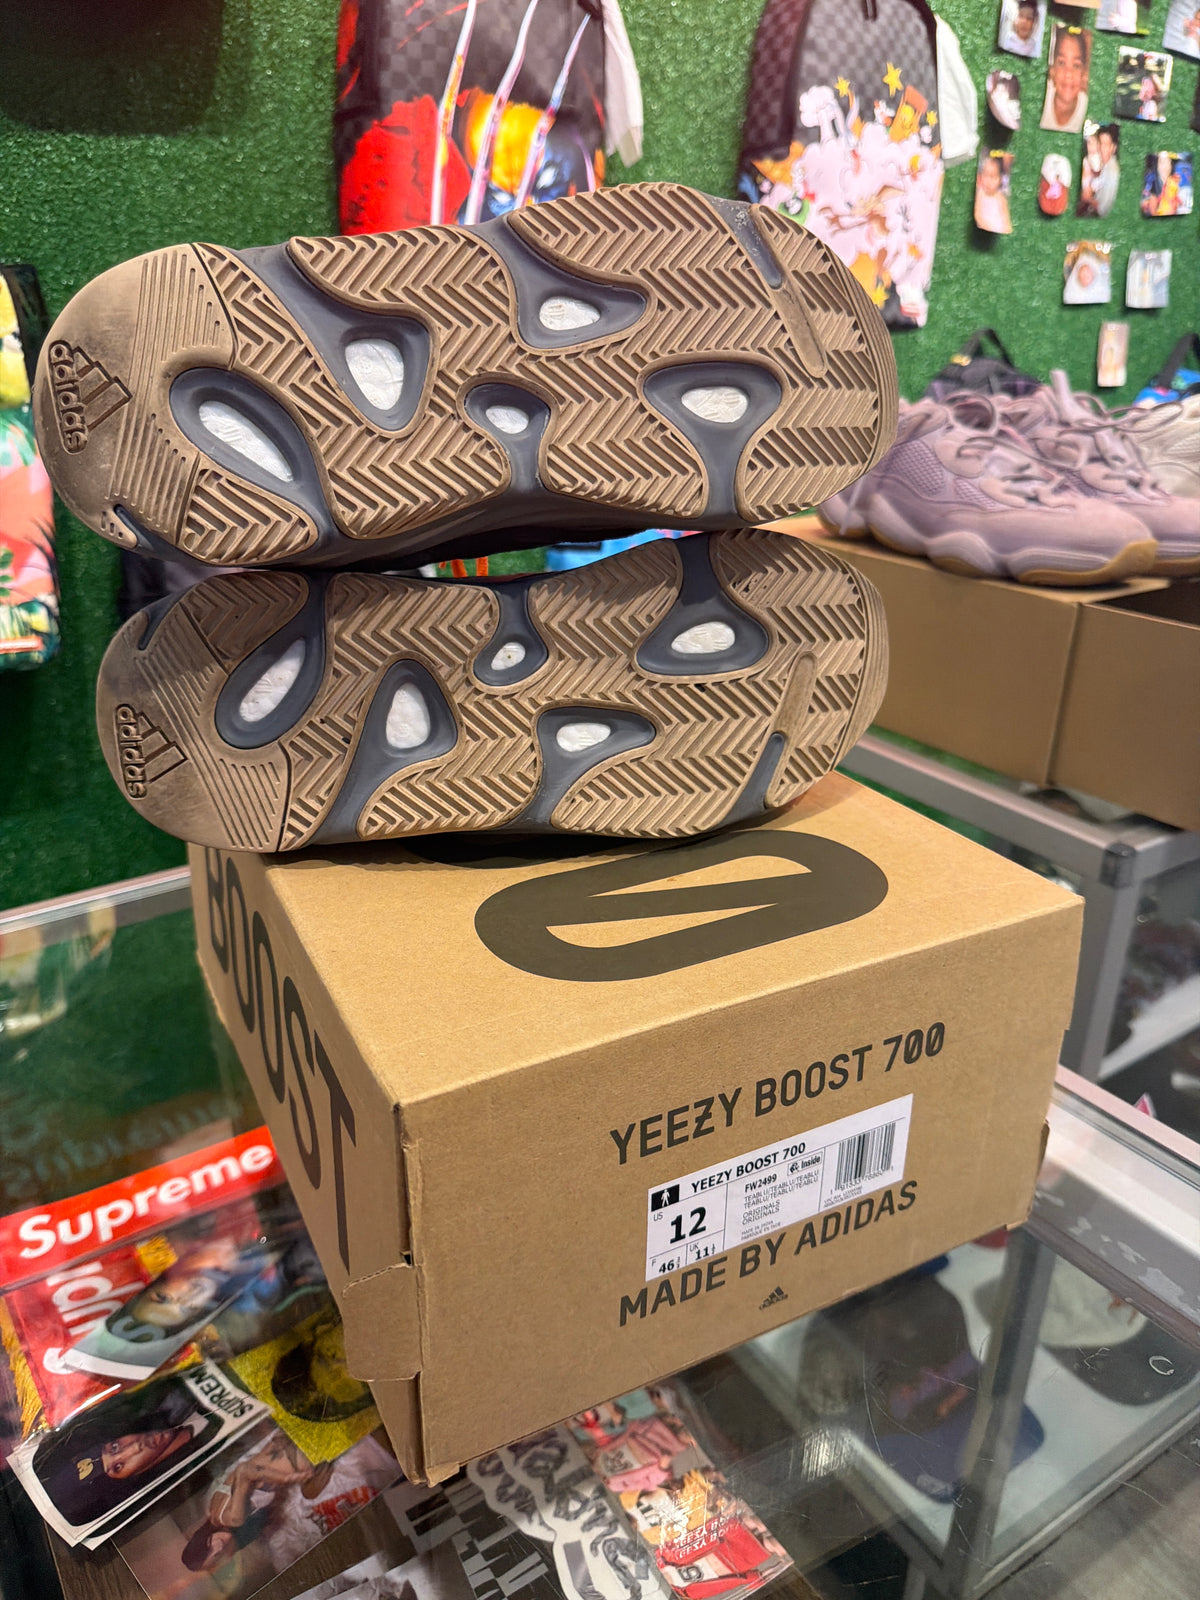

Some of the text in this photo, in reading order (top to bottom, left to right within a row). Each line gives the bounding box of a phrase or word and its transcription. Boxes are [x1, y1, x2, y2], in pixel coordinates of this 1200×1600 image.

[50, 343, 88, 454] adidas
[116, 706, 148, 798] adidas
[205, 847, 356, 1276] BOOST
[609, 1021, 946, 1166] YEEZY BOOST 700
[691, 1141, 806, 1194] YEEZY BOOST 700
[744, 1173, 778, 1193] FW2499
[18, 1144, 274, 1259] Supreme
[653, 1211, 664, 1222] US
[669, 1206, 707, 1245] 12
[741, 1206, 780, 1226] ORIGINALS
[742, 1200, 781, 1220] ORIGINALS
[619, 1179, 918, 1328] MADE BY ADIDAS
[689, 1242, 700, 1252] UK
